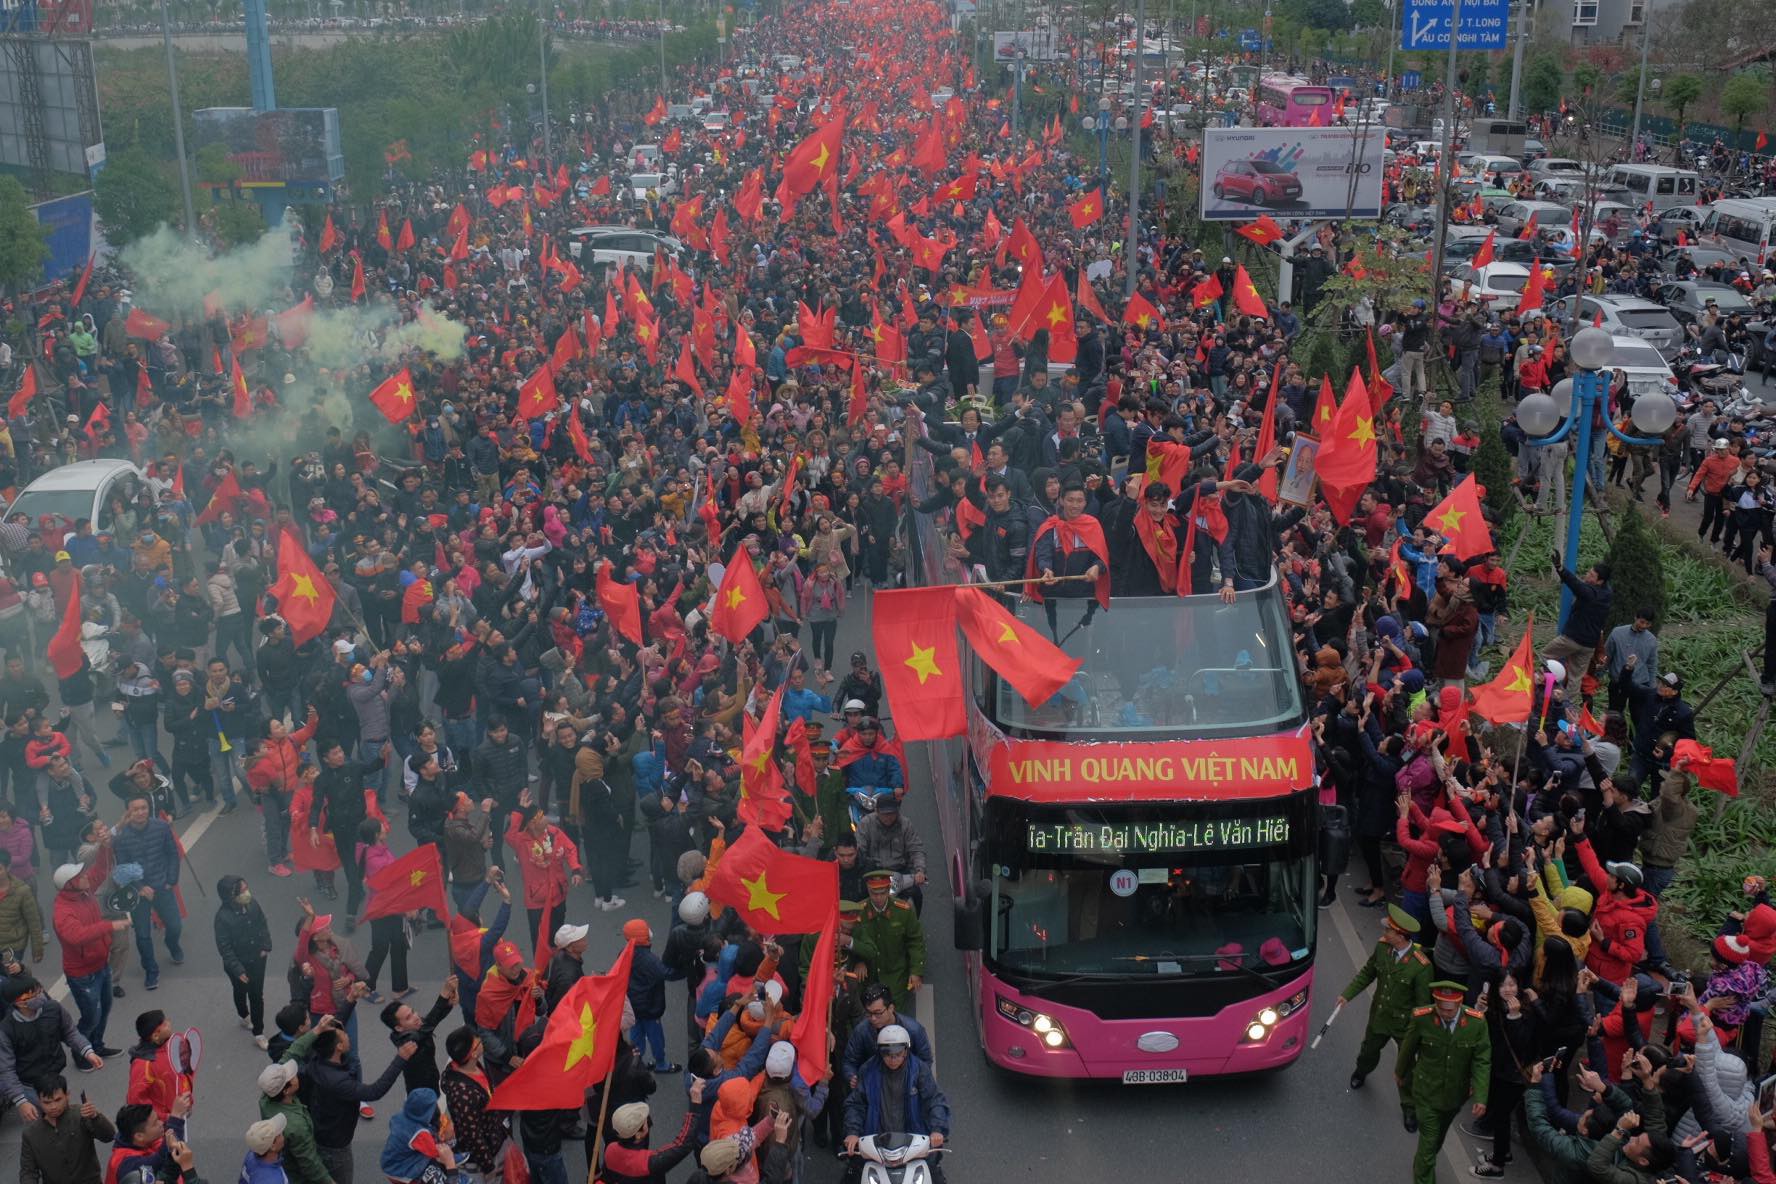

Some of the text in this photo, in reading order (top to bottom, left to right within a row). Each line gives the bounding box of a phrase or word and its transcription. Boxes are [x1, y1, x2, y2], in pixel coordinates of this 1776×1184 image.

[1009, 751, 1298, 787] VINH QUANG VIỆT NAM
[1100, 825, 1129, 852] Đại
[1220, 819, 1252, 845] Văn
[1116, 877, 1132, 889] N1
